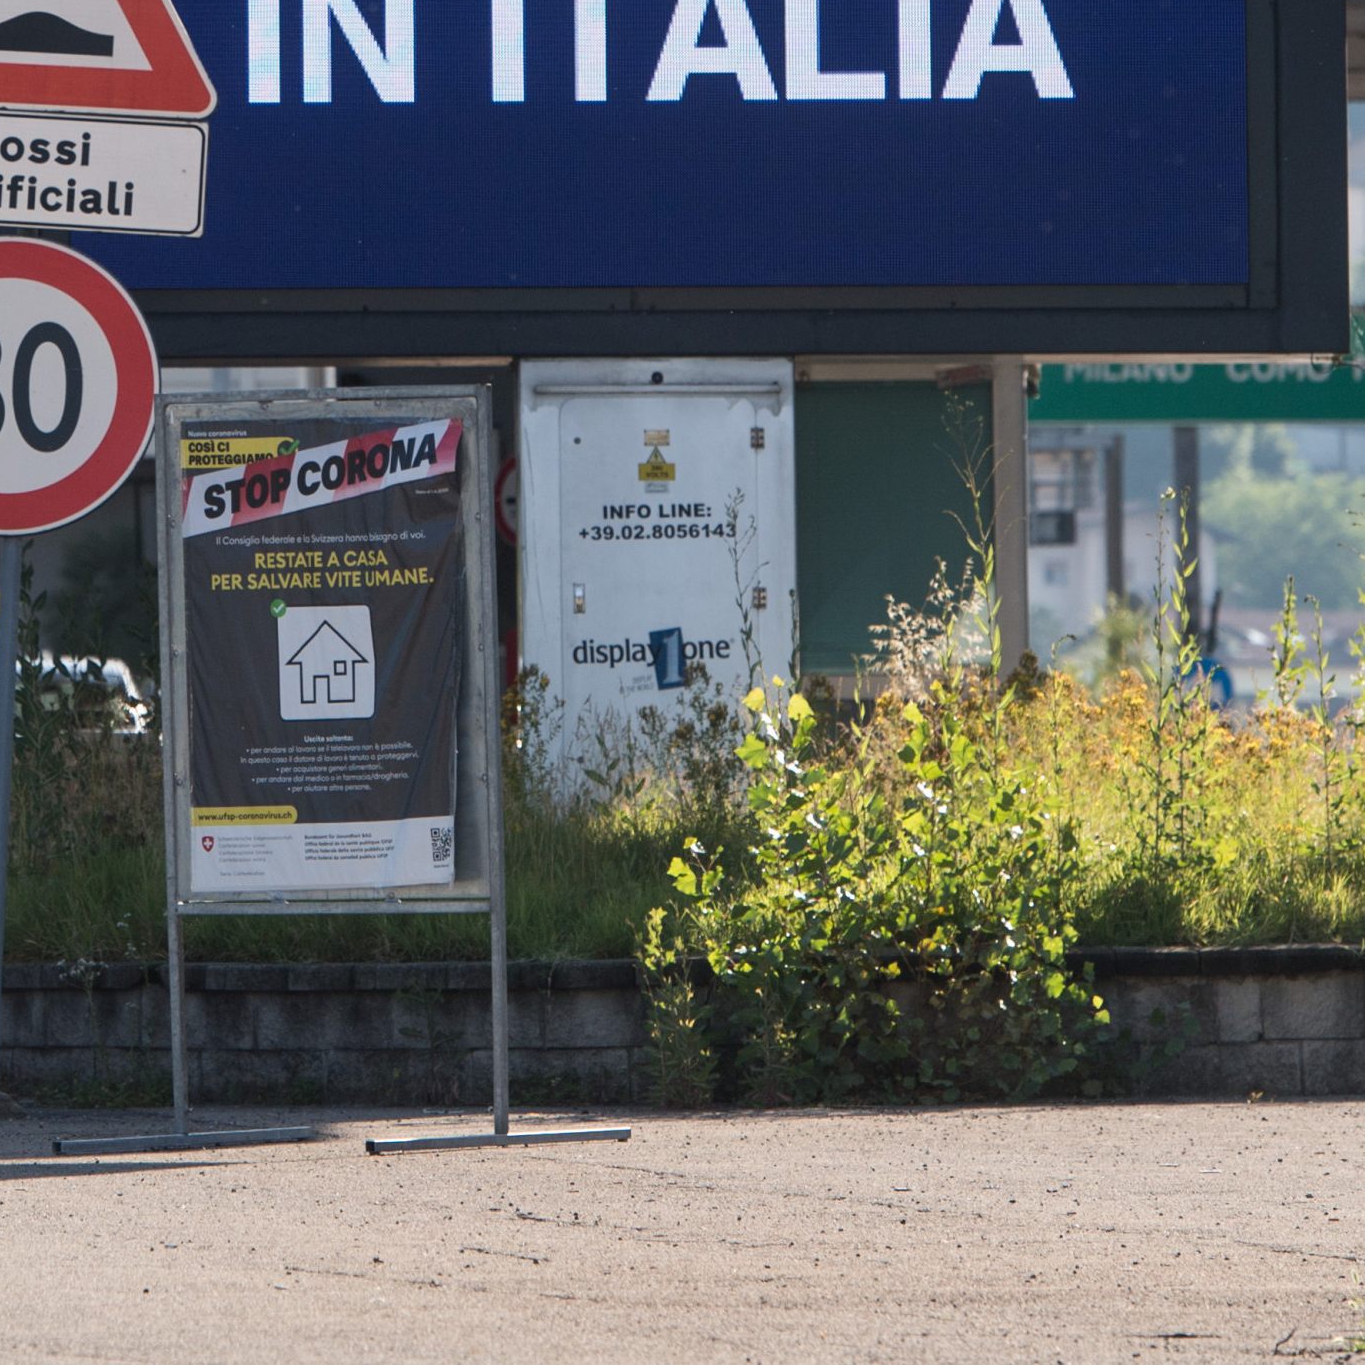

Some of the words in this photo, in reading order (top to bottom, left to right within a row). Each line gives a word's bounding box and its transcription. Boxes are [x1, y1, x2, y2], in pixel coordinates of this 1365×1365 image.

[188, 440, 215, 453] COSÌ
[217, 441, 230, 453] CI
[204, 468, 292, 519] STOP
[297, 433, 437, 497] CORONA
[602, 504, 651, 519] INFO
[658, 503, 712, 518] LINE:
[222, 535, 260, 547] Consiglio
[261, 535, 295, 545] federale
[296, 536, 302, 544] e
[311, 533, 344, 544] Svizzera
[345, 533, 368, 542] hanno
[369, 532, 399, 543] bisogno
[399, 530, 409, 540] di
[410, 529, 426, 540] voi.
[579, 523, 737, 541] +39.02.8056143
[254, 551, 323, 569] RESTATE
[327, 551, 340, 568] A
[343, 549, 388, 566] CASA
[211, 573, 243, 590] PER
[247, 572, 322, 590] SALVARE
[325, 571, 362, 588] VITE
[364, 567, 434, 587] UMANE.
[198, 811, 293, 822] www.ufsp-coronavirus.ch
